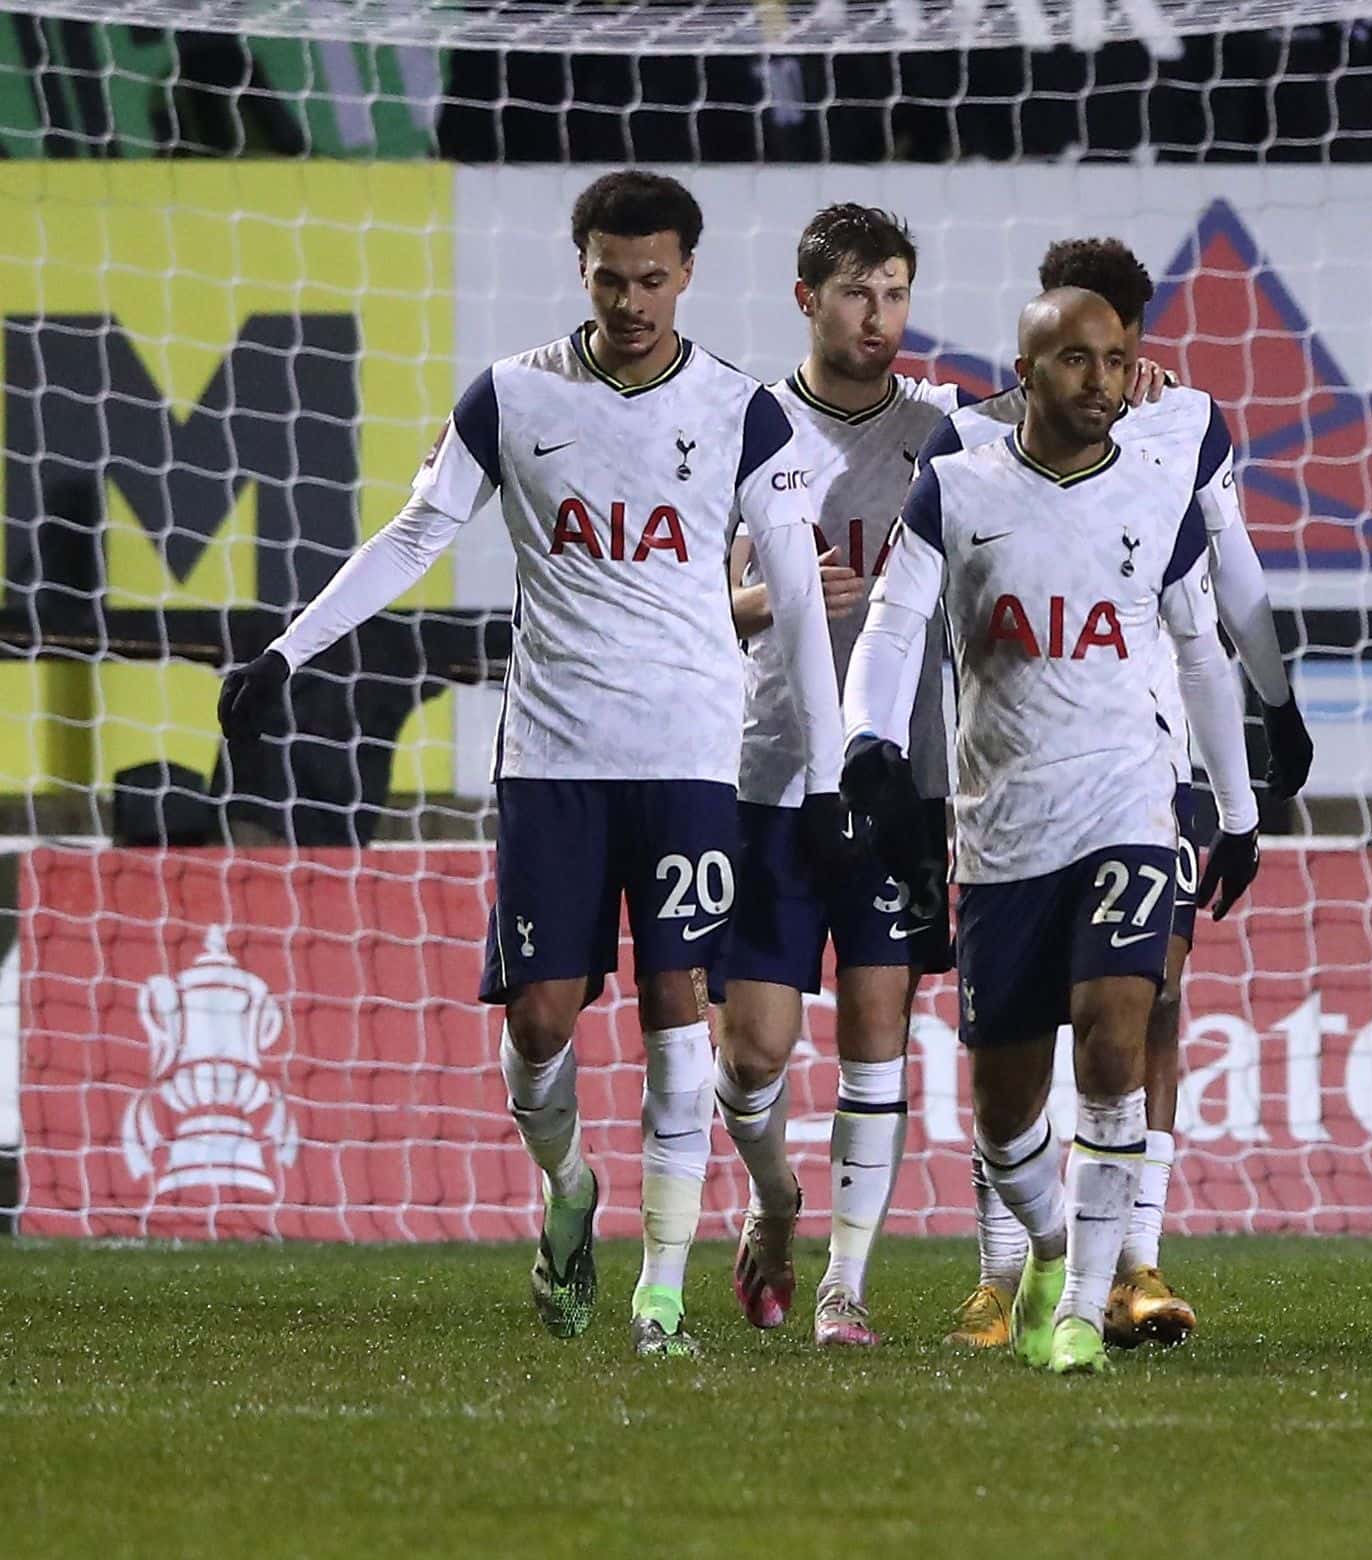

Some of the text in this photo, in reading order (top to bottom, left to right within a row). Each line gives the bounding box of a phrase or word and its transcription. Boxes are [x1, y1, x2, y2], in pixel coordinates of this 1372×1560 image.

[550, 498, 688, 563] AIA
[990, 595, 1128, 660] AIA
[656, 850, 736, 918] 20
[1091, 860, 1168, 927] 27
